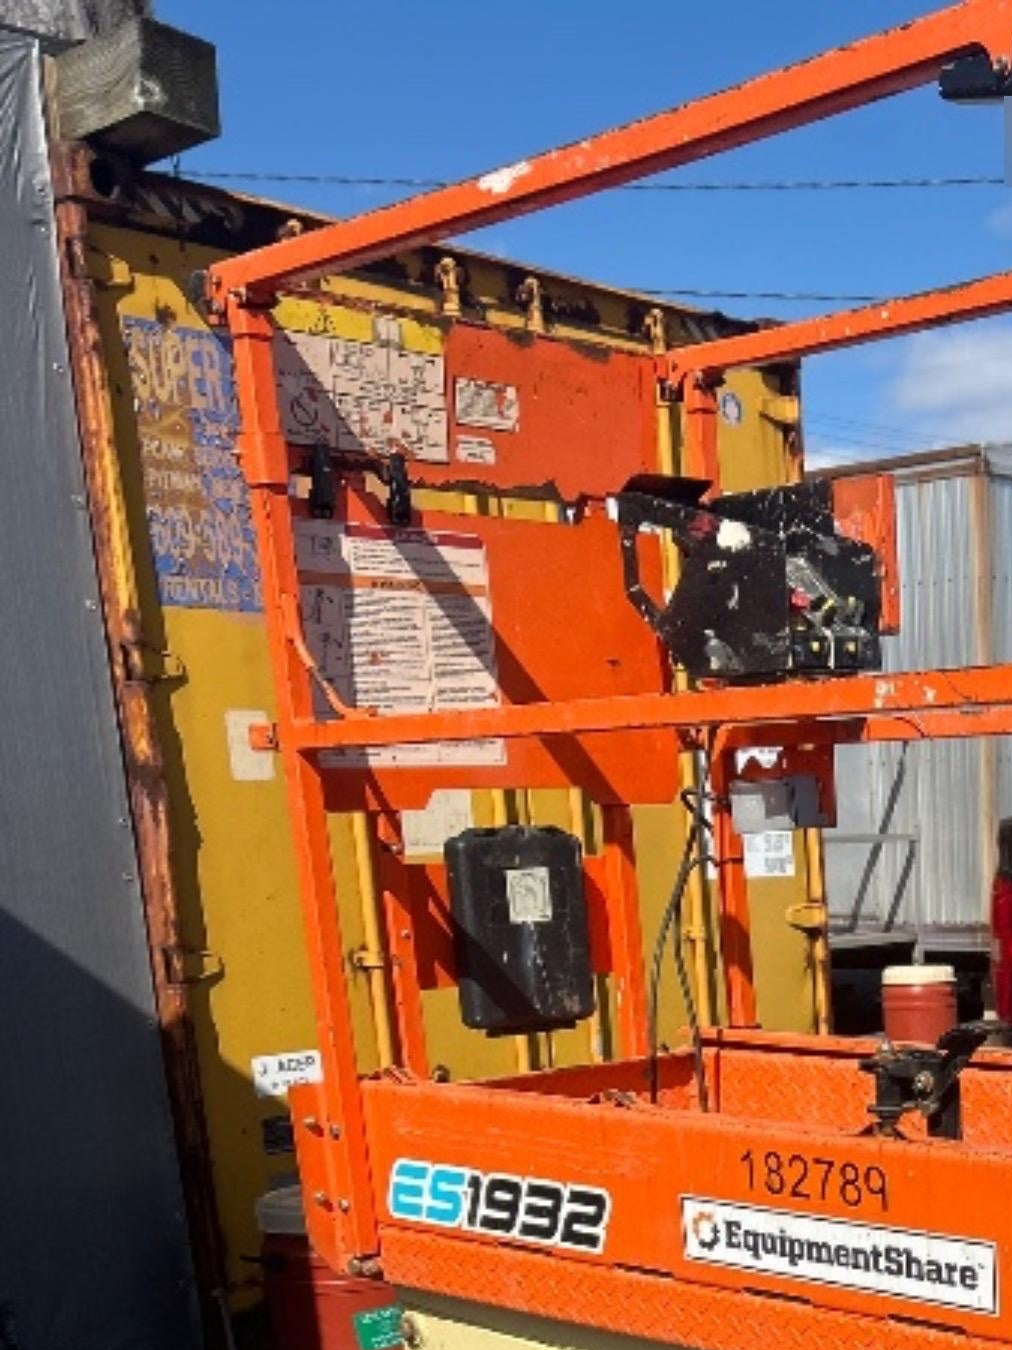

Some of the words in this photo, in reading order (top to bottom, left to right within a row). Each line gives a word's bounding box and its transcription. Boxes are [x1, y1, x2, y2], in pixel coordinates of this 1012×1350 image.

[126, 326, 227, 412] SUPER
[390, 1161, 609, 1250] ES1932
[740, 1150, 889, 1212] 182789
[723, 1219, 979, 1291] EquipmentShare
